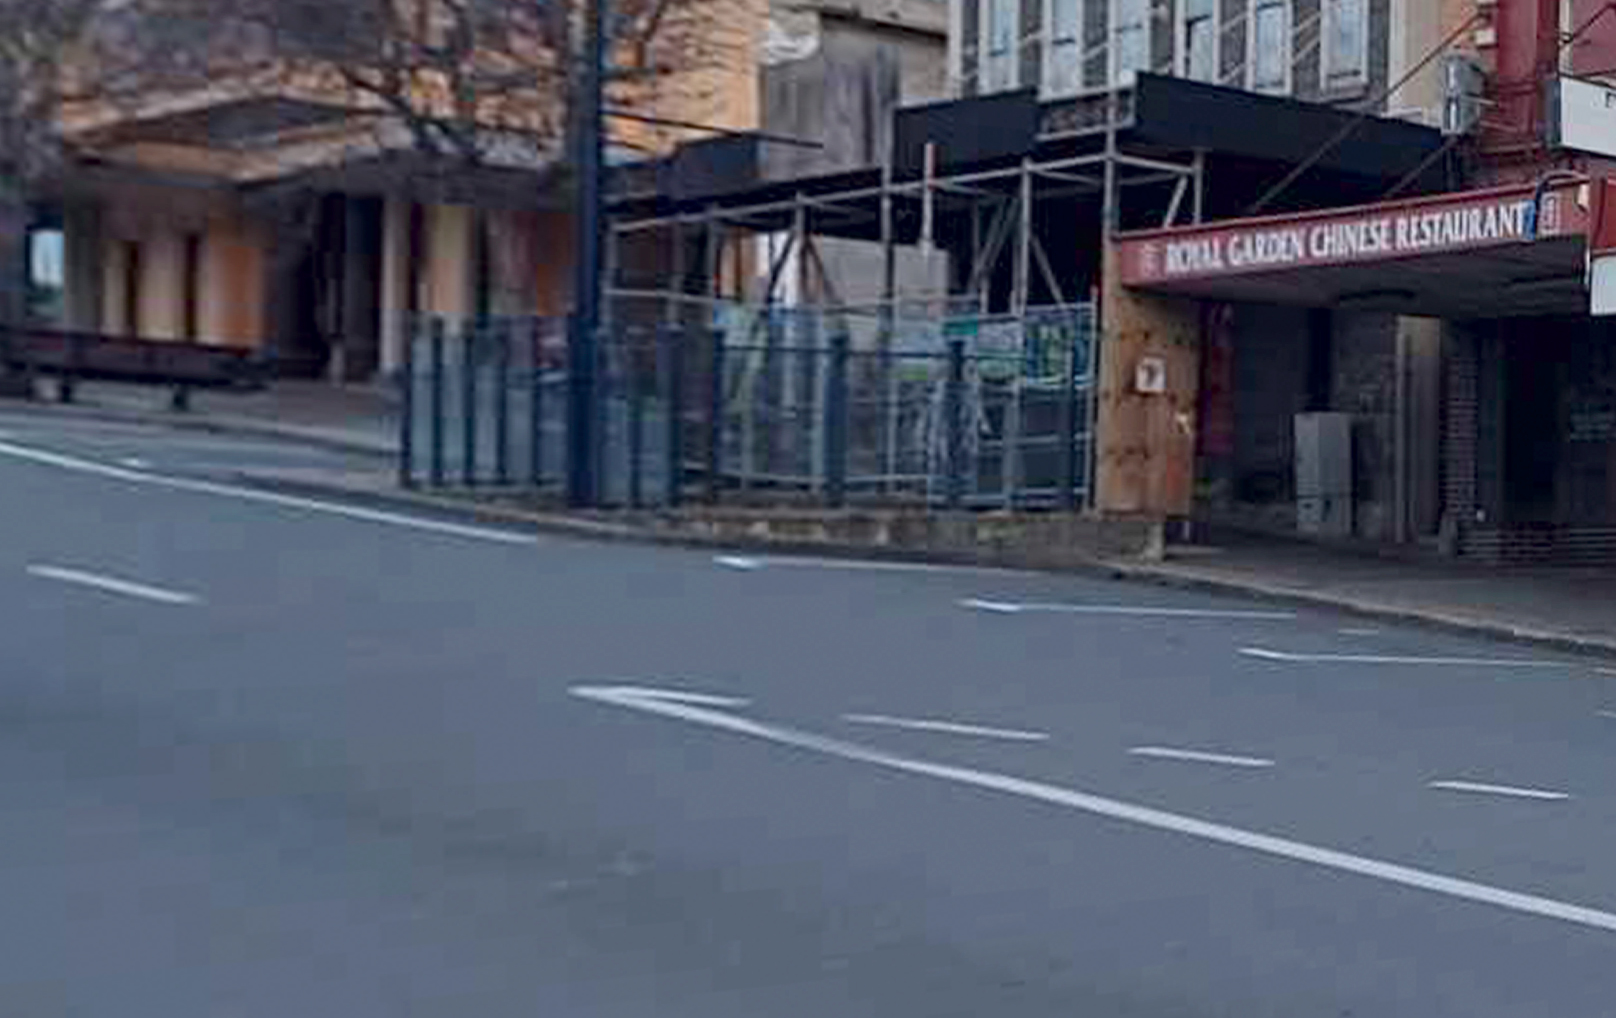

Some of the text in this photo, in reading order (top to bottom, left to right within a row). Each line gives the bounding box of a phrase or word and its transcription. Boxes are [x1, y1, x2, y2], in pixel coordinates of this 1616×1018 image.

[1166, 237, 1224, 273] ROYAL
[1227, 228, 1305, 267] GARDEN
[1309, 216, 1393, 259] CHINESE
[1395, 201, 1524, 251] RESTAURANT
